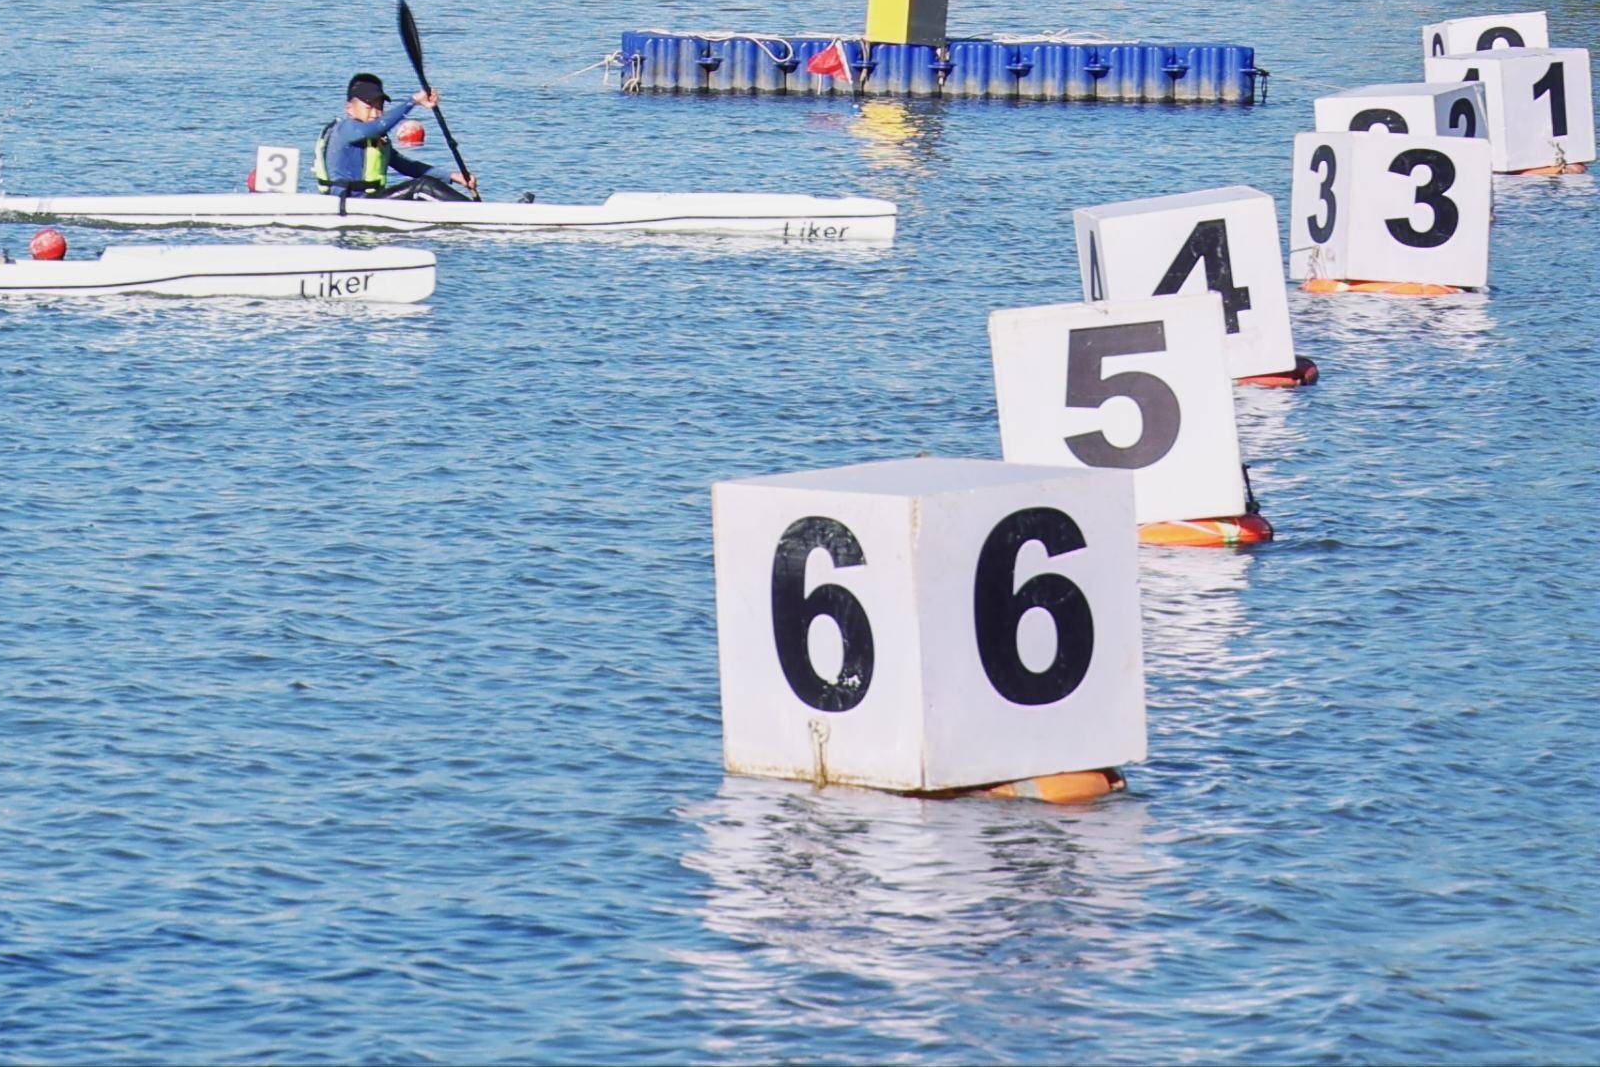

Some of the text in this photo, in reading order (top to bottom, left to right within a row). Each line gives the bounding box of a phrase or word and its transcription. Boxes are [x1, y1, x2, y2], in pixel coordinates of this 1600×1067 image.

[1533, 62, 1568, 137] 1
[266, 153, 288, 186] 3
[1307, 144, 1337, 244] 3
[1384, 148, 1459, 248] 3
[783, 221, 849, 239] Liker
[1152, 218, 1251, 334] 4
[301, 272, 374, 298] Liker
[1063, 320, 1181, 470] 5
[771, 515, 875, 713] 6
[974, 506, 1095, 706] 6
